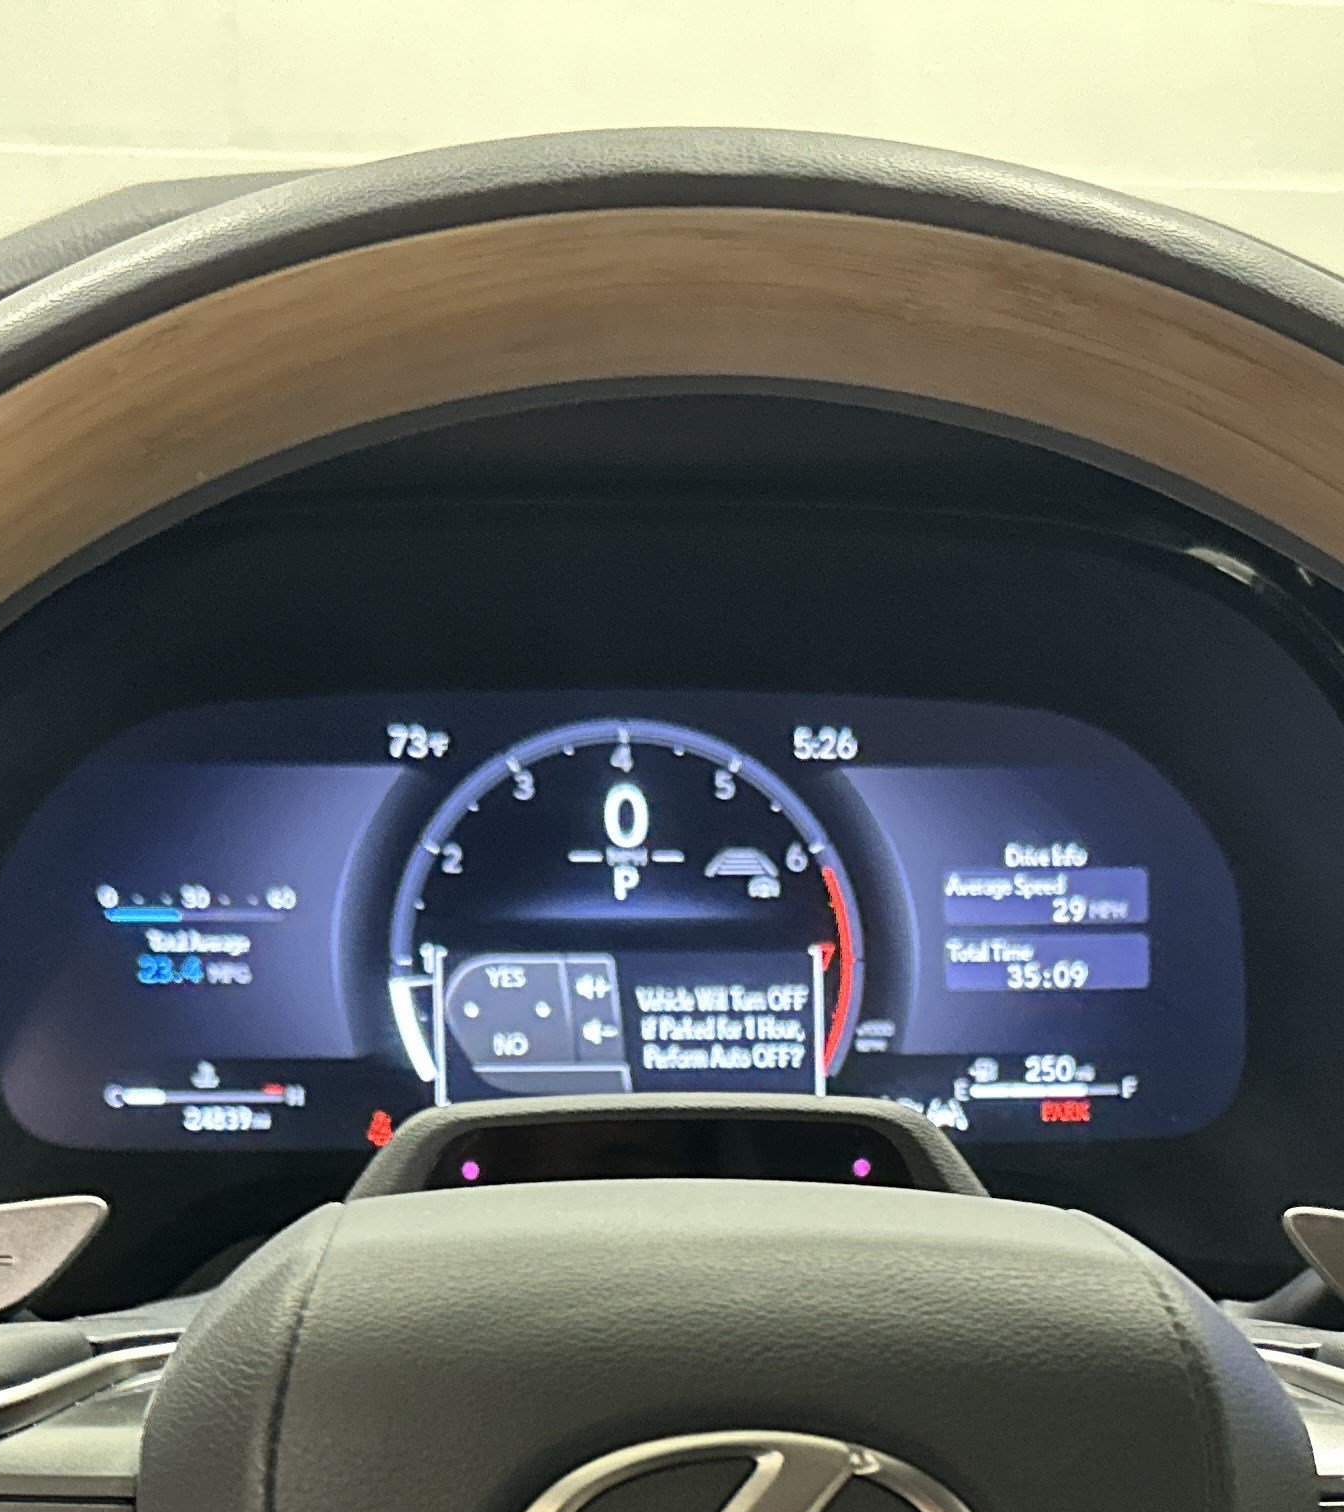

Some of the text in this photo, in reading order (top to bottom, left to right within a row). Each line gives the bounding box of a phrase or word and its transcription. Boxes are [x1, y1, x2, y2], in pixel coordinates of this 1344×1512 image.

[792, 726, 858, 761] 5:26
[611, 747, 633, 772] 4
[513, 771, 535, 801] 3
[714, 771, 736, 800] 5
[604, 783, 649, 848] 0
[442, 842, 463, 874] 2
[786, 842, 808, 873] 6
[613, 864, 640, 901] P
[945, 872, 1068, 900] Average Speed
[1052, 895, 1088, 924] 29
[946, 937, 1035, 963] Total Time
[485, 966, 527, 988] YES
[1007, 960, 1089, 989] 35:09
[767, 984, 809, 1012] OFF
[493, 1032, 529, 1056] NO
[709, 1043, 752, 1070] Auto
[752, 1042, 805, 1070] OFF?
[1024, 1054, 1077, 1082] 250
[1122, 1075, 1139, 1099] F
